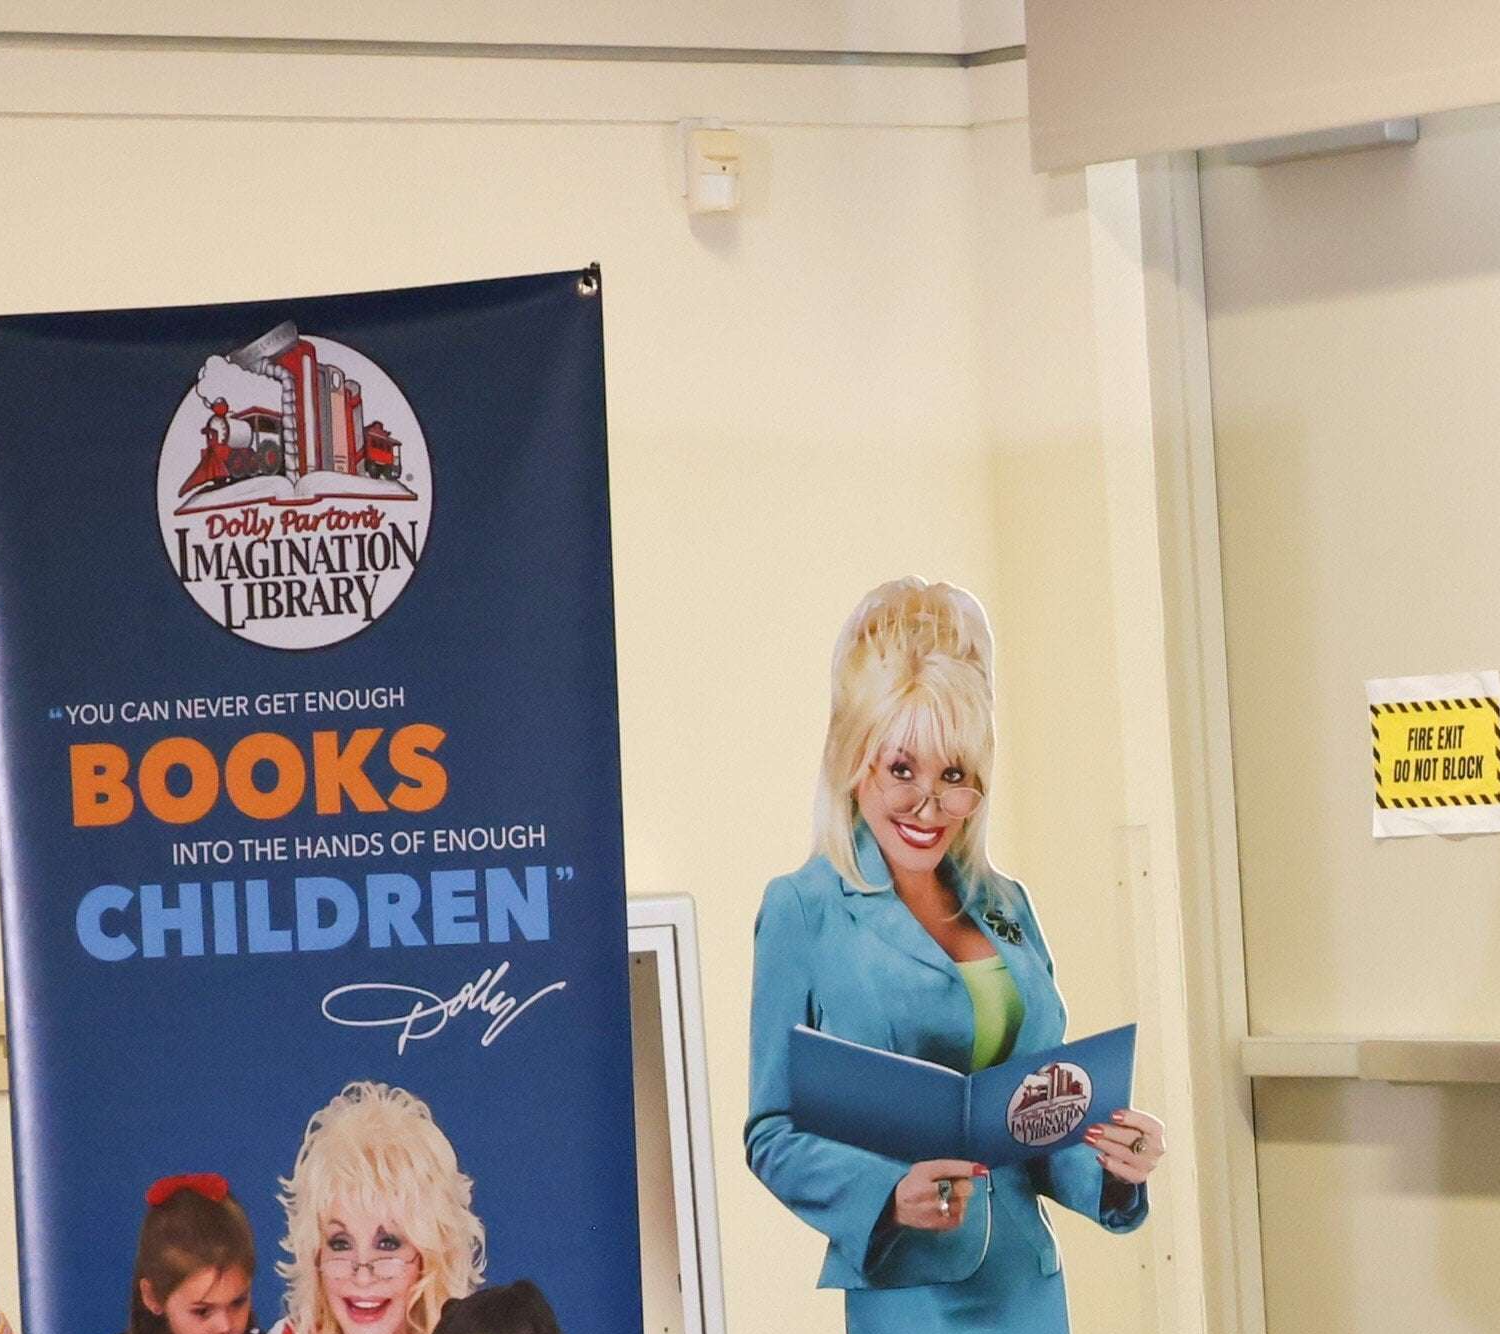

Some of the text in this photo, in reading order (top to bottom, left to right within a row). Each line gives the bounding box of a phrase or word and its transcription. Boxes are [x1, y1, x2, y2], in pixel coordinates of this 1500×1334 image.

[206, 504, 387, 541] Dolly Parton's
[174, 520, 419, 583] IMAGINATION
[222, 574, 381, 630] LIBRARY
[120, 700, 171, 722] CAN
[176, 696, 249, 720] NEVER
[255, 693, 301, 716] GET
[305, 686, 405, 713] ENOUGH
[1407, 725, 1465, 752] FIRE EXIT
[69, 723, 449, 827] BOOKS
[1393, 755, 1485, 783] DO NOT BLOCK
[172, 824, 547, 865] INTO THE HANDS OF ENOUGH
[321, 960, 567, 1055] Dolly
